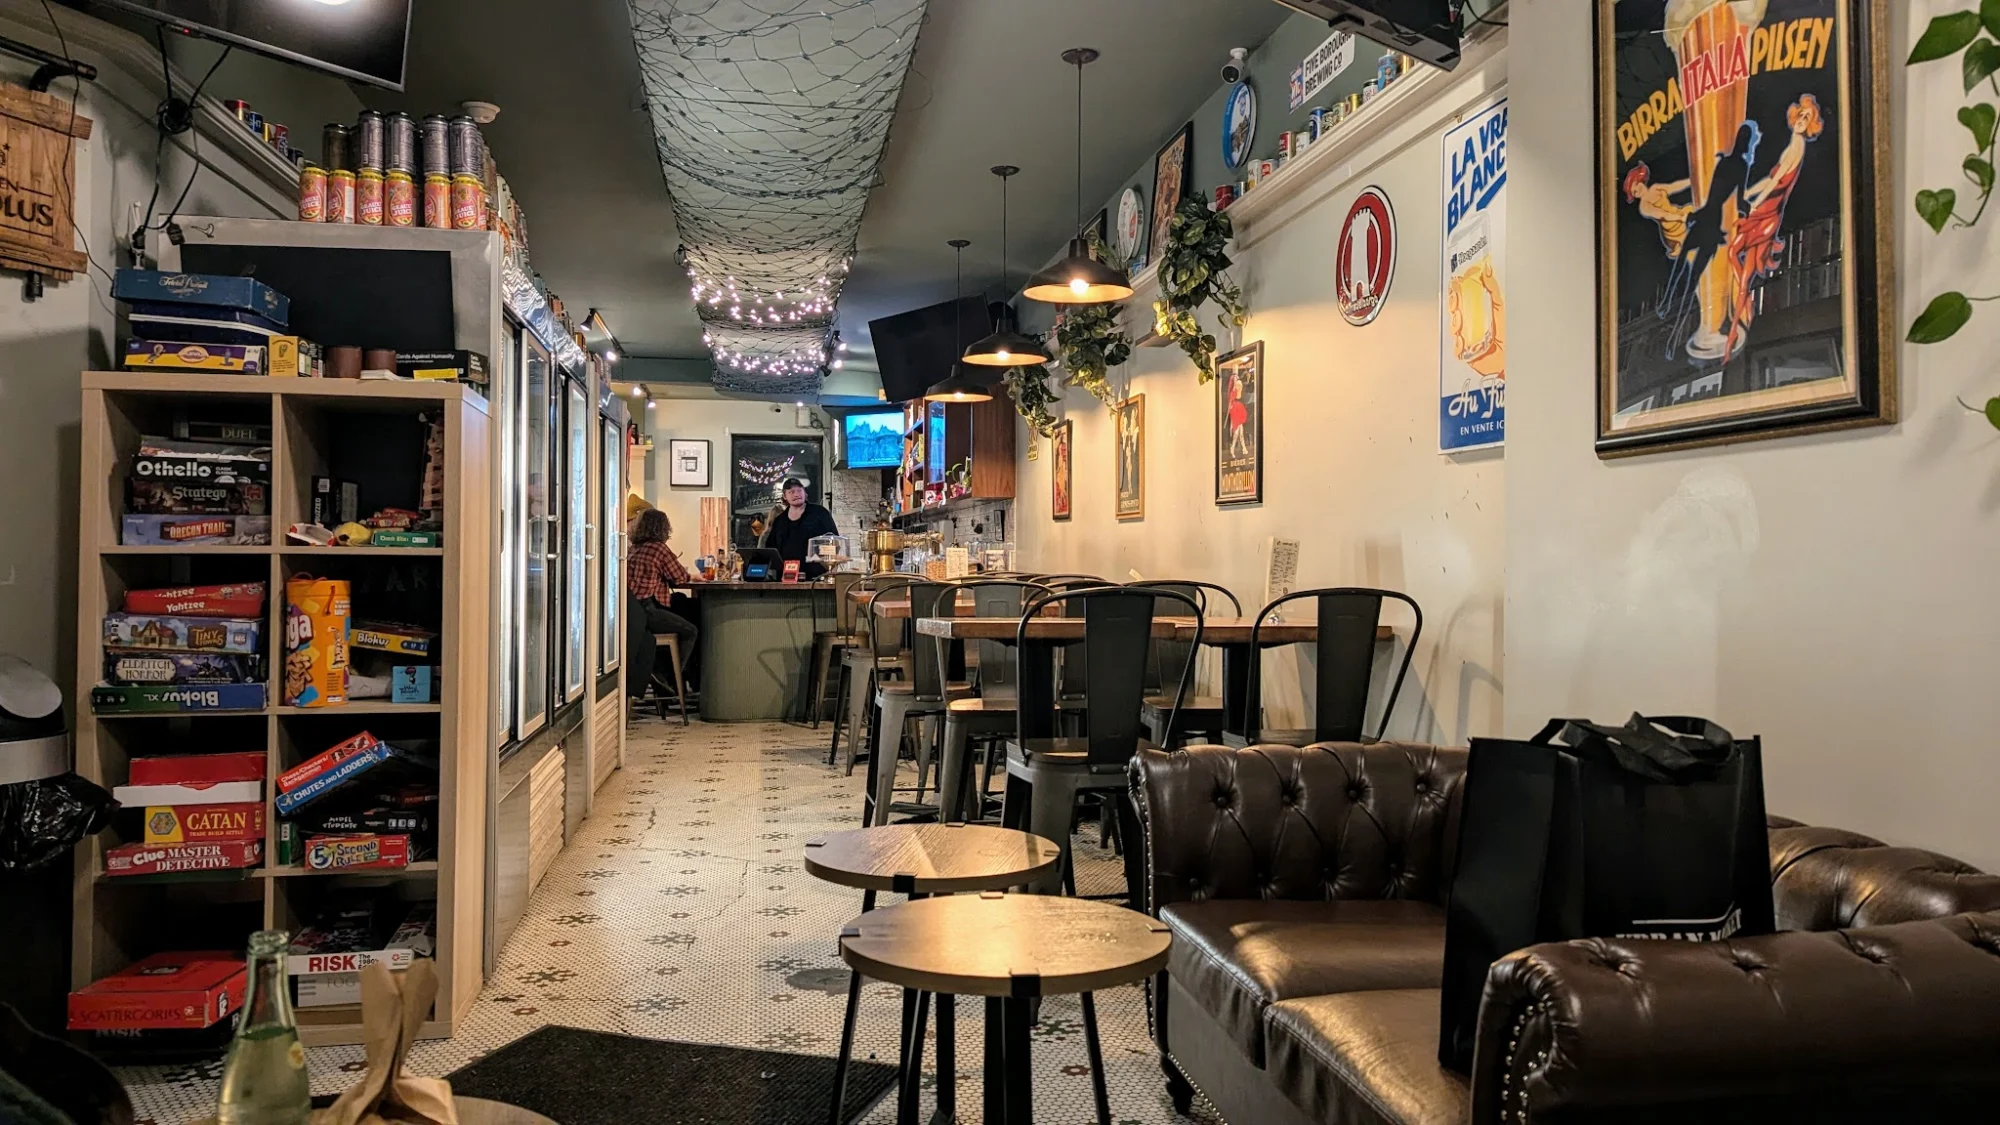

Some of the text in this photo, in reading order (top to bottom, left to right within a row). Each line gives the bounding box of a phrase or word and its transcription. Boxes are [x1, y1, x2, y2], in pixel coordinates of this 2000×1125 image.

[1305, 53, 1319, 77] FIVE
[1305, 60, 1333, 96] BREWING
[1617, 17, 1834, 162] BIRRA ITALA PILSEN
[1452, 136, 1476, 191] LA
[411, 353, 430, 361] Against
[431, 353, 455, 361] Humanity
[222, 427, 257, 439] DUEL
[1460, 426, 1469, 436] EN
[1472, 421, 1494, 434] VENTE
[136, 460, 212, 478] Othello
[172, 486, 227, 501] Stratego
[169, 522, 227, 539] OREGON TRAIL
[166, 601, 206, 613] Yahtzee
[192, 627, 218, 646] TINY
[357, 632, 390, 645] Blokus
[122, 659, 171, 669] ELDRITCH
[125, 669, 167, 680] HORROR
[162, 690, 219, 707] Blokus
[293, 753, 373, 801] CHUTES AND LADDERS
[186, 812, 247, 831] CATAN
[132, 850, 166, 866] Clue
[167, 845, 221, 860] MASTER
[314, 847, 328, 866] 5
[337, 842, 377, 856] SECOND
[335, 853, 362, 867] RULE
[156, 857, 231, 872] DETECTIVE
[307, 954, 358, 973] RISK
[80, 1008, 181, 1023] SCATTERGORIES
